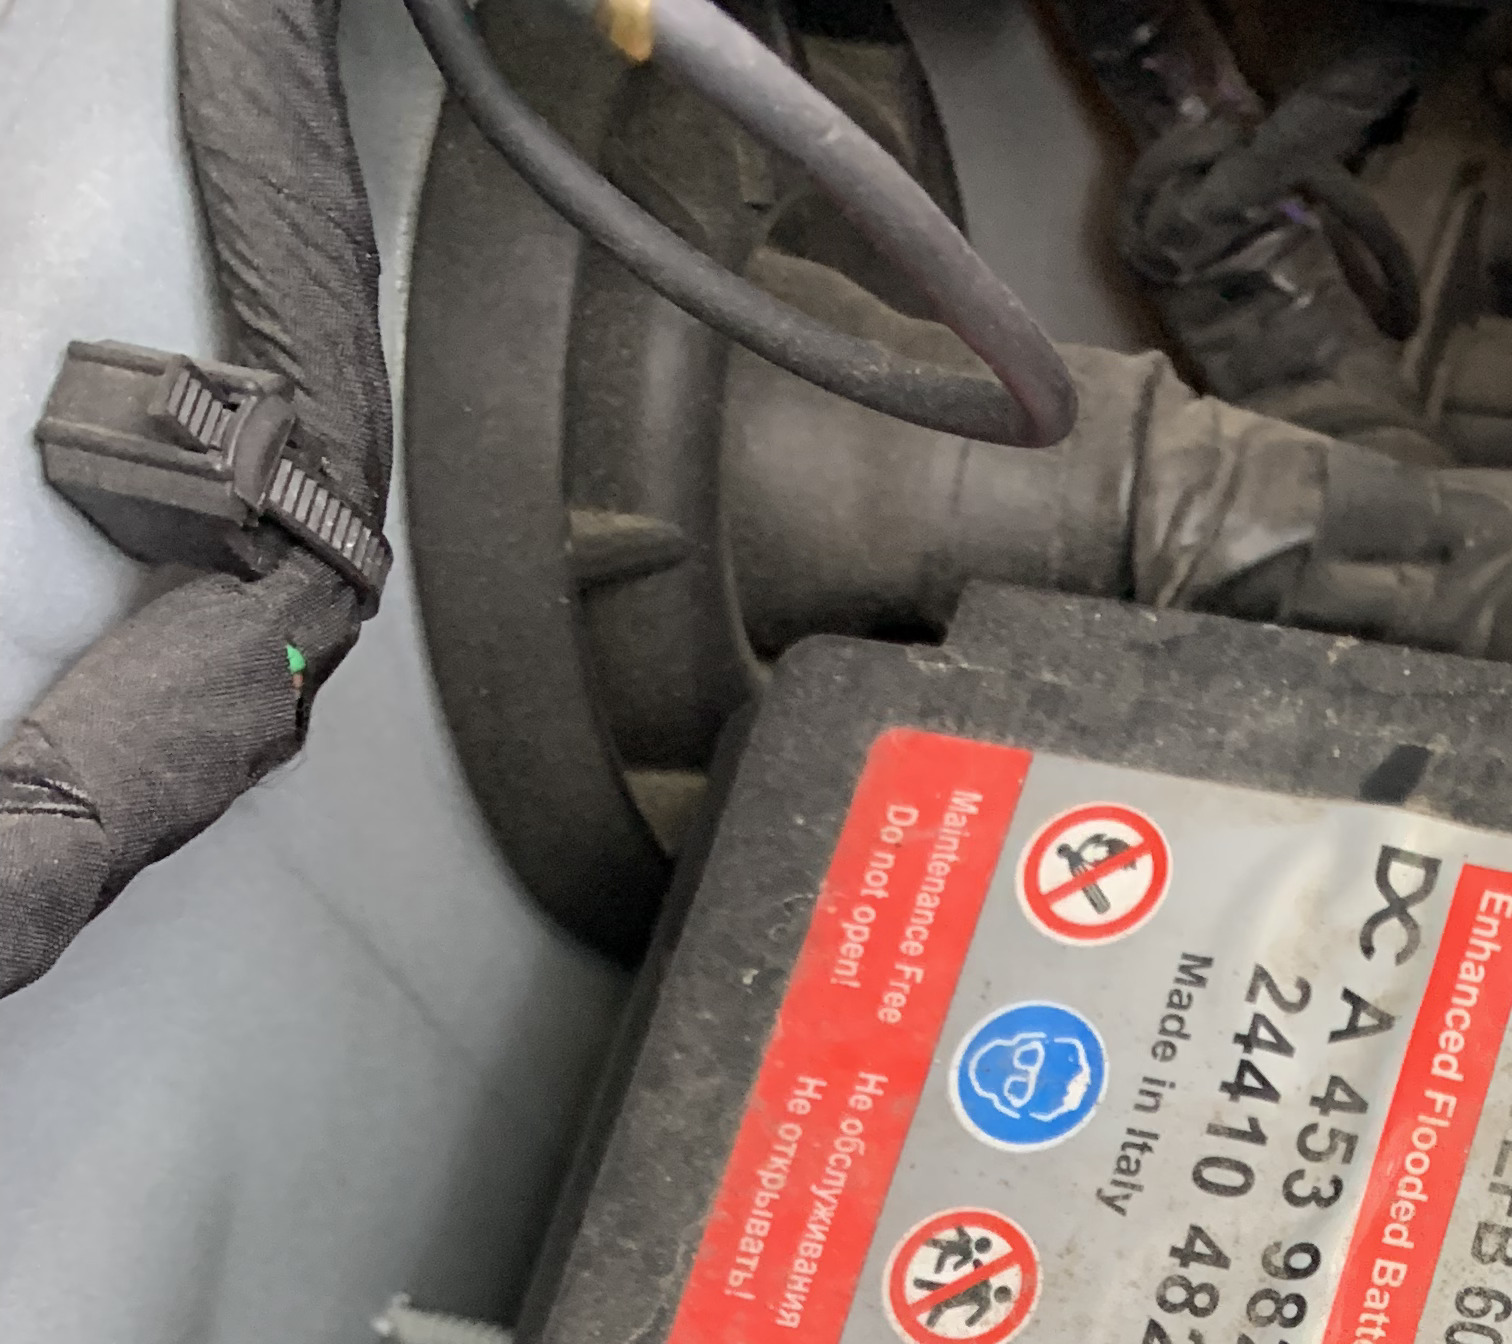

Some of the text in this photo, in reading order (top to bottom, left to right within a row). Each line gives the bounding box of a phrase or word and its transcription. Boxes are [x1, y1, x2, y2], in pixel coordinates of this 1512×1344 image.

[830, 803, 919, 988] Do not open!
[877, 789, 983, 1023] Maintenance Free
[1095, 952, 1214, 1216] Made in Italy
[1191, 964, 1311, 1197] 24410
[1327, 986, 1396, 1043] A
[724, 1075, 827, 1300] Не открывать!
[774, 1071, 888, 1328] Не обслуживания
[1281, 1074, 1369, 1209] 453
[1381, 1089, 1457, 1248] Flooded
